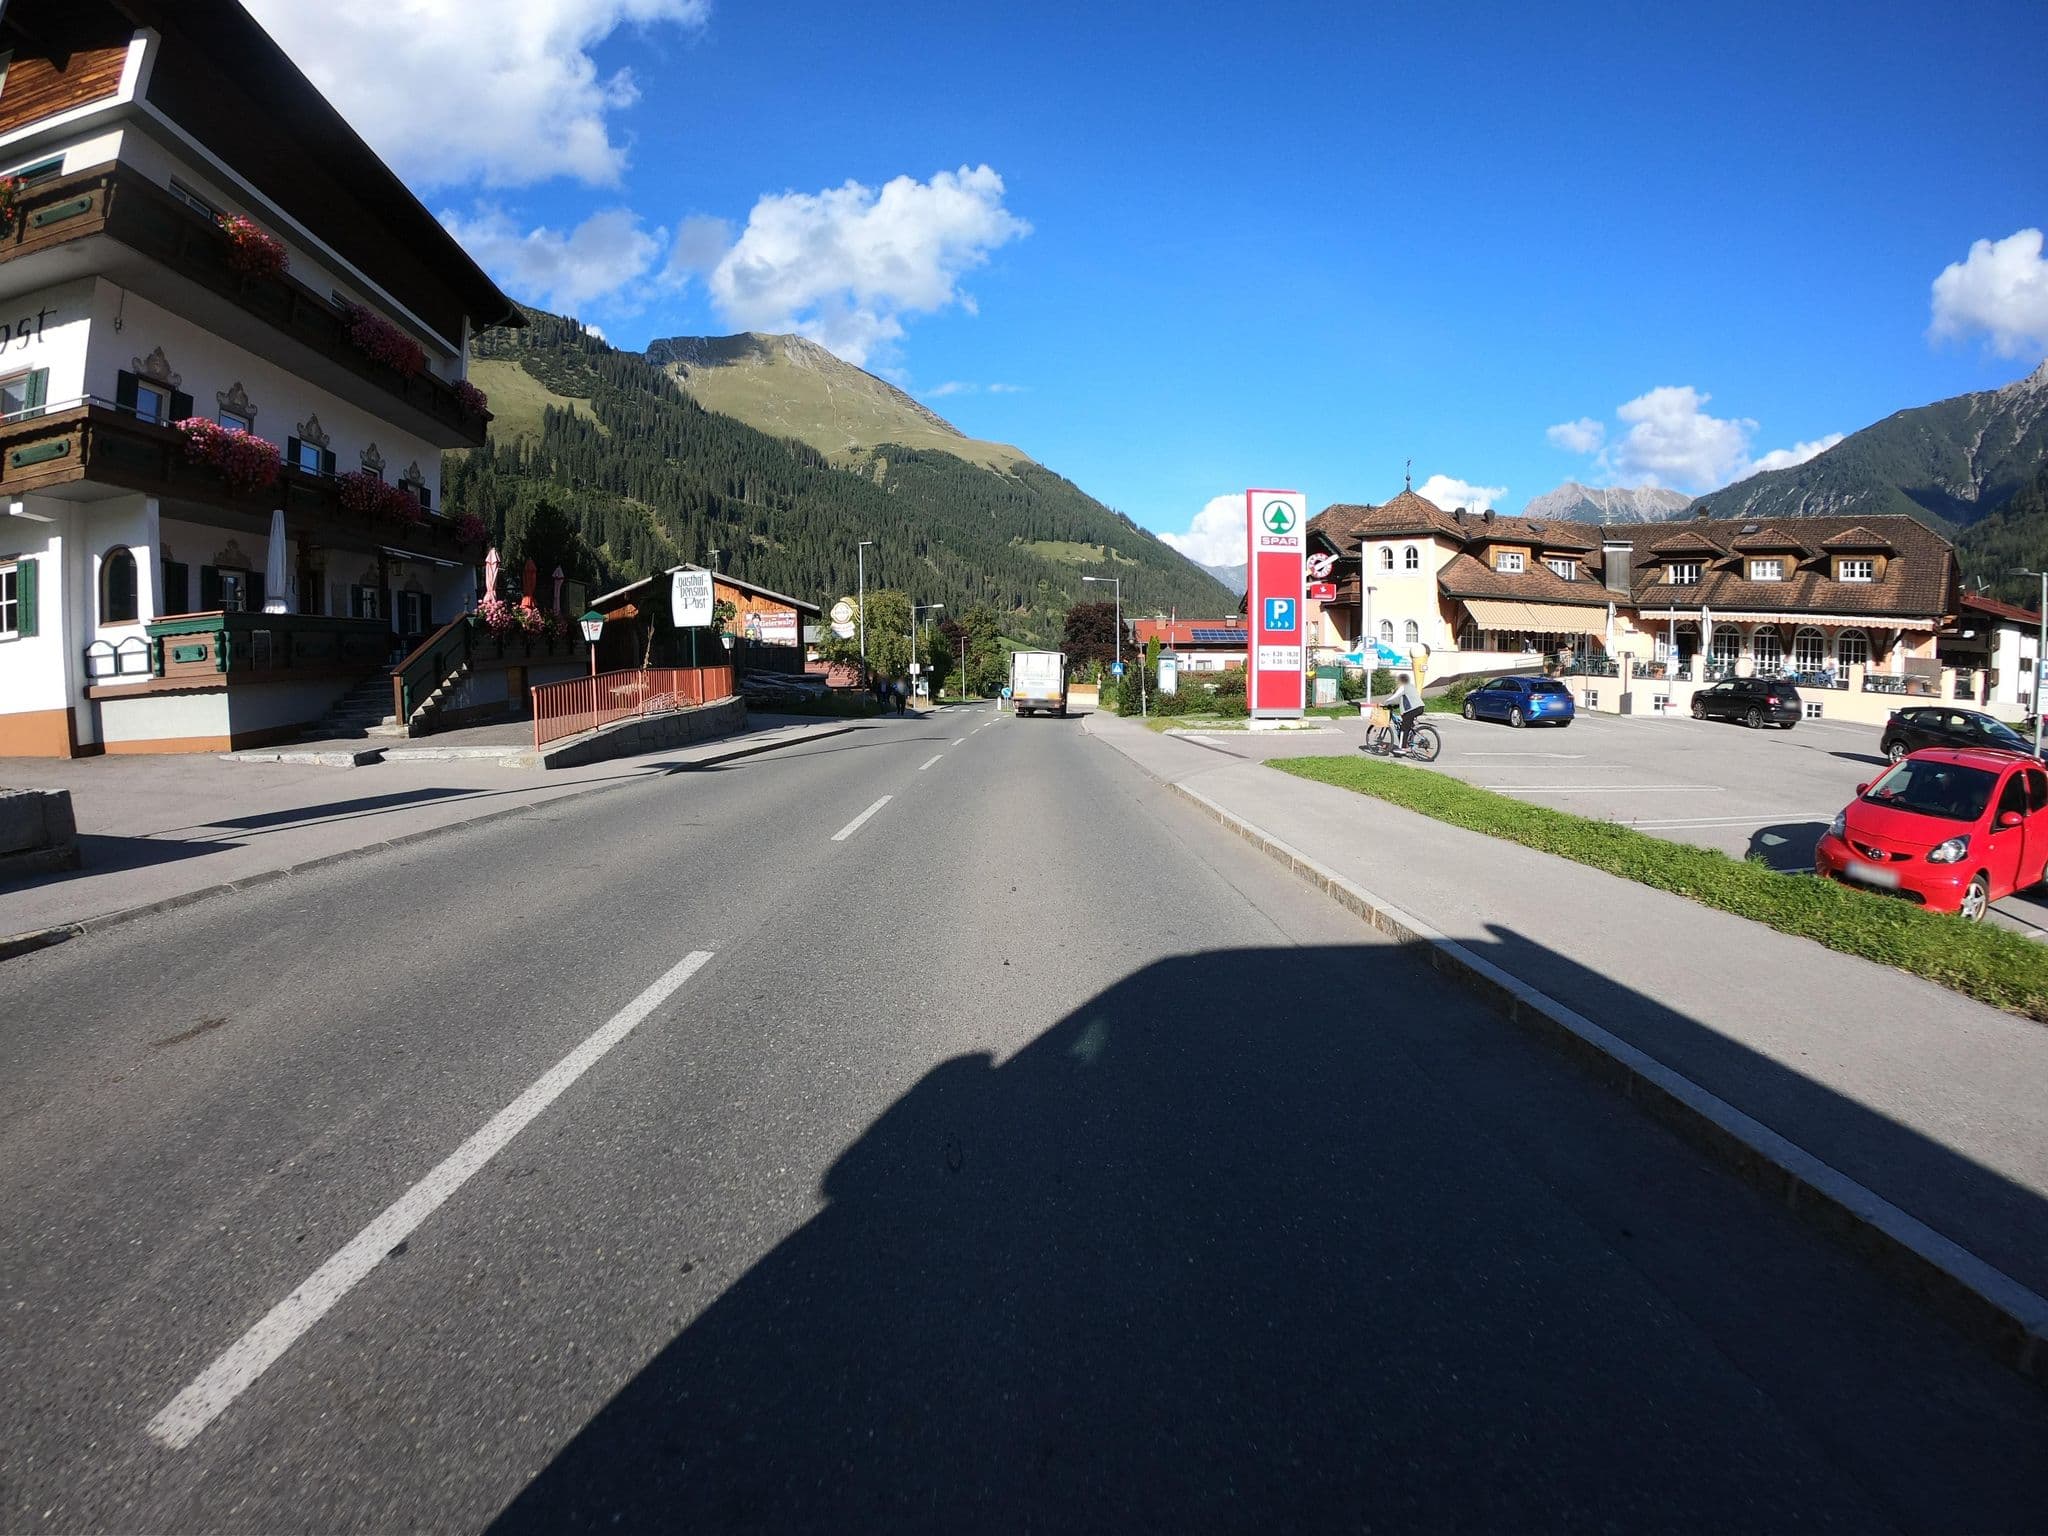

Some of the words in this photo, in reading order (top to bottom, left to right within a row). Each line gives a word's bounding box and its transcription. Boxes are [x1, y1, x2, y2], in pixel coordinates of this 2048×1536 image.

[1262, 537, 1298, 546] SPAR
[684, 597, 707, 609] Post
[1273, 601, 1288, 619] P
[1366, 637, 1375, 647] P
